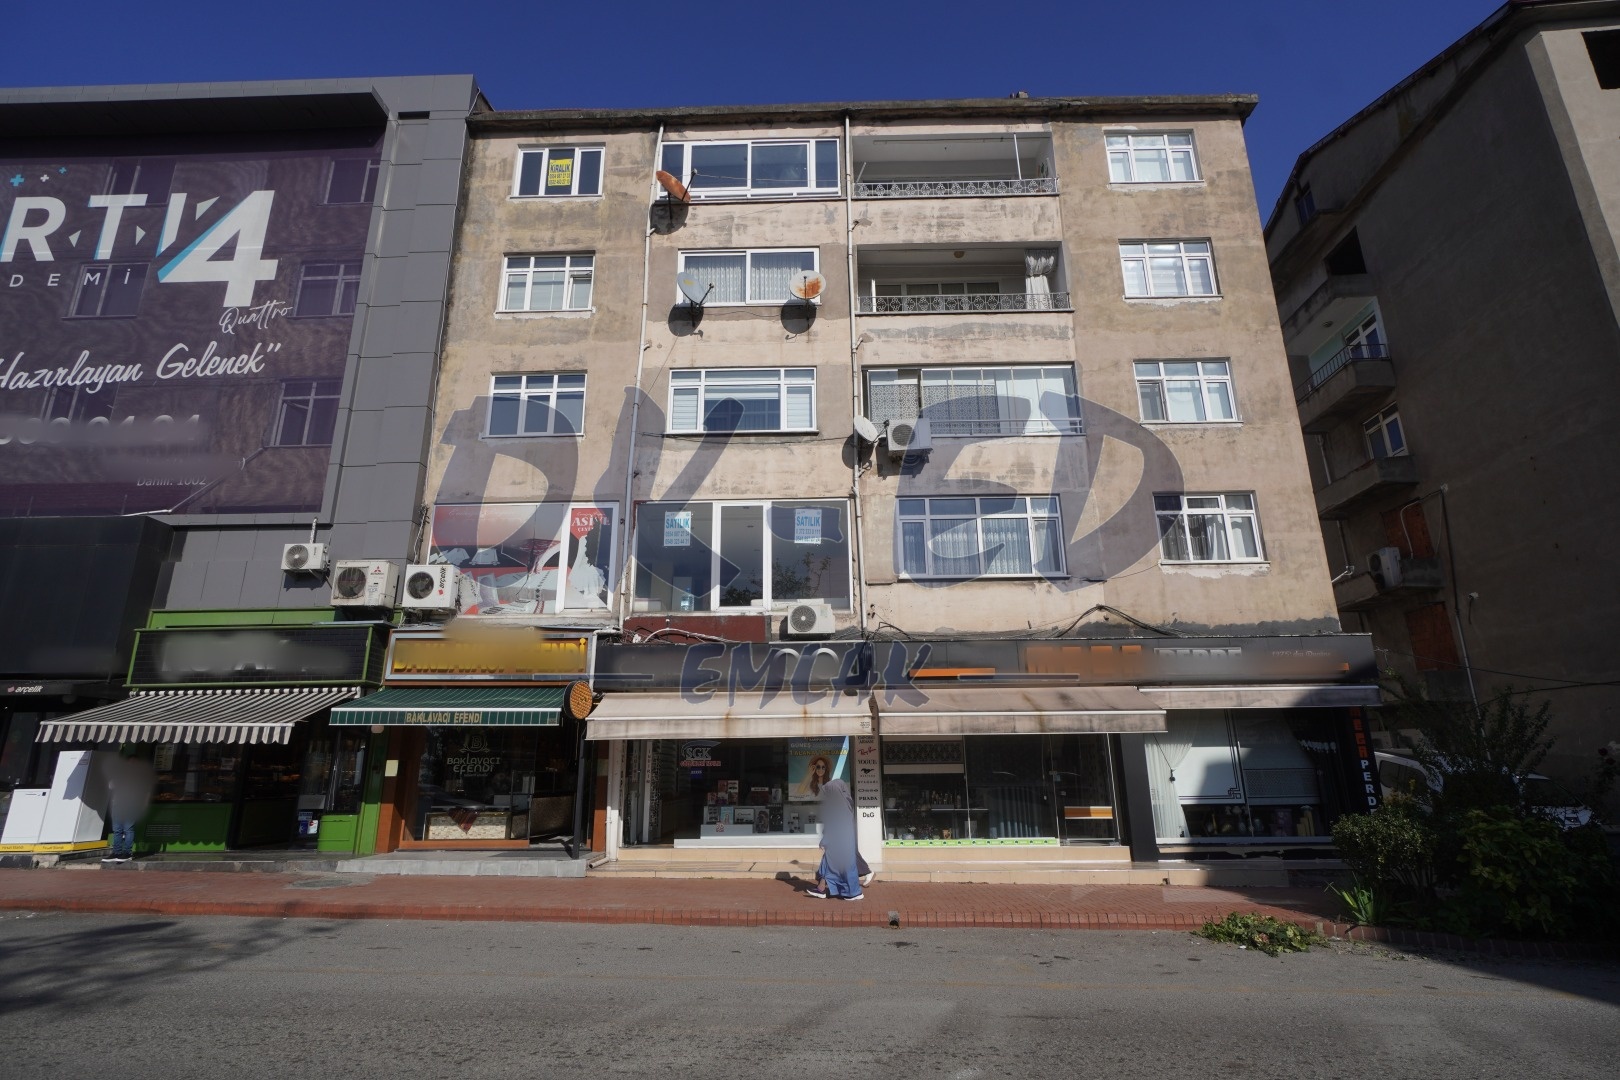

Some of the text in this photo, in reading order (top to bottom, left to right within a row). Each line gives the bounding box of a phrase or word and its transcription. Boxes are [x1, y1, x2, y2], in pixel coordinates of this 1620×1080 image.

[218, 300, 293, 335] Quattro
[665, 517, 690, 529] SATILIK
[796, 516, 821, 527] SATILIK
[15, 685, 43, 694] arçelik
[684, 747, 712, 760] SGK
